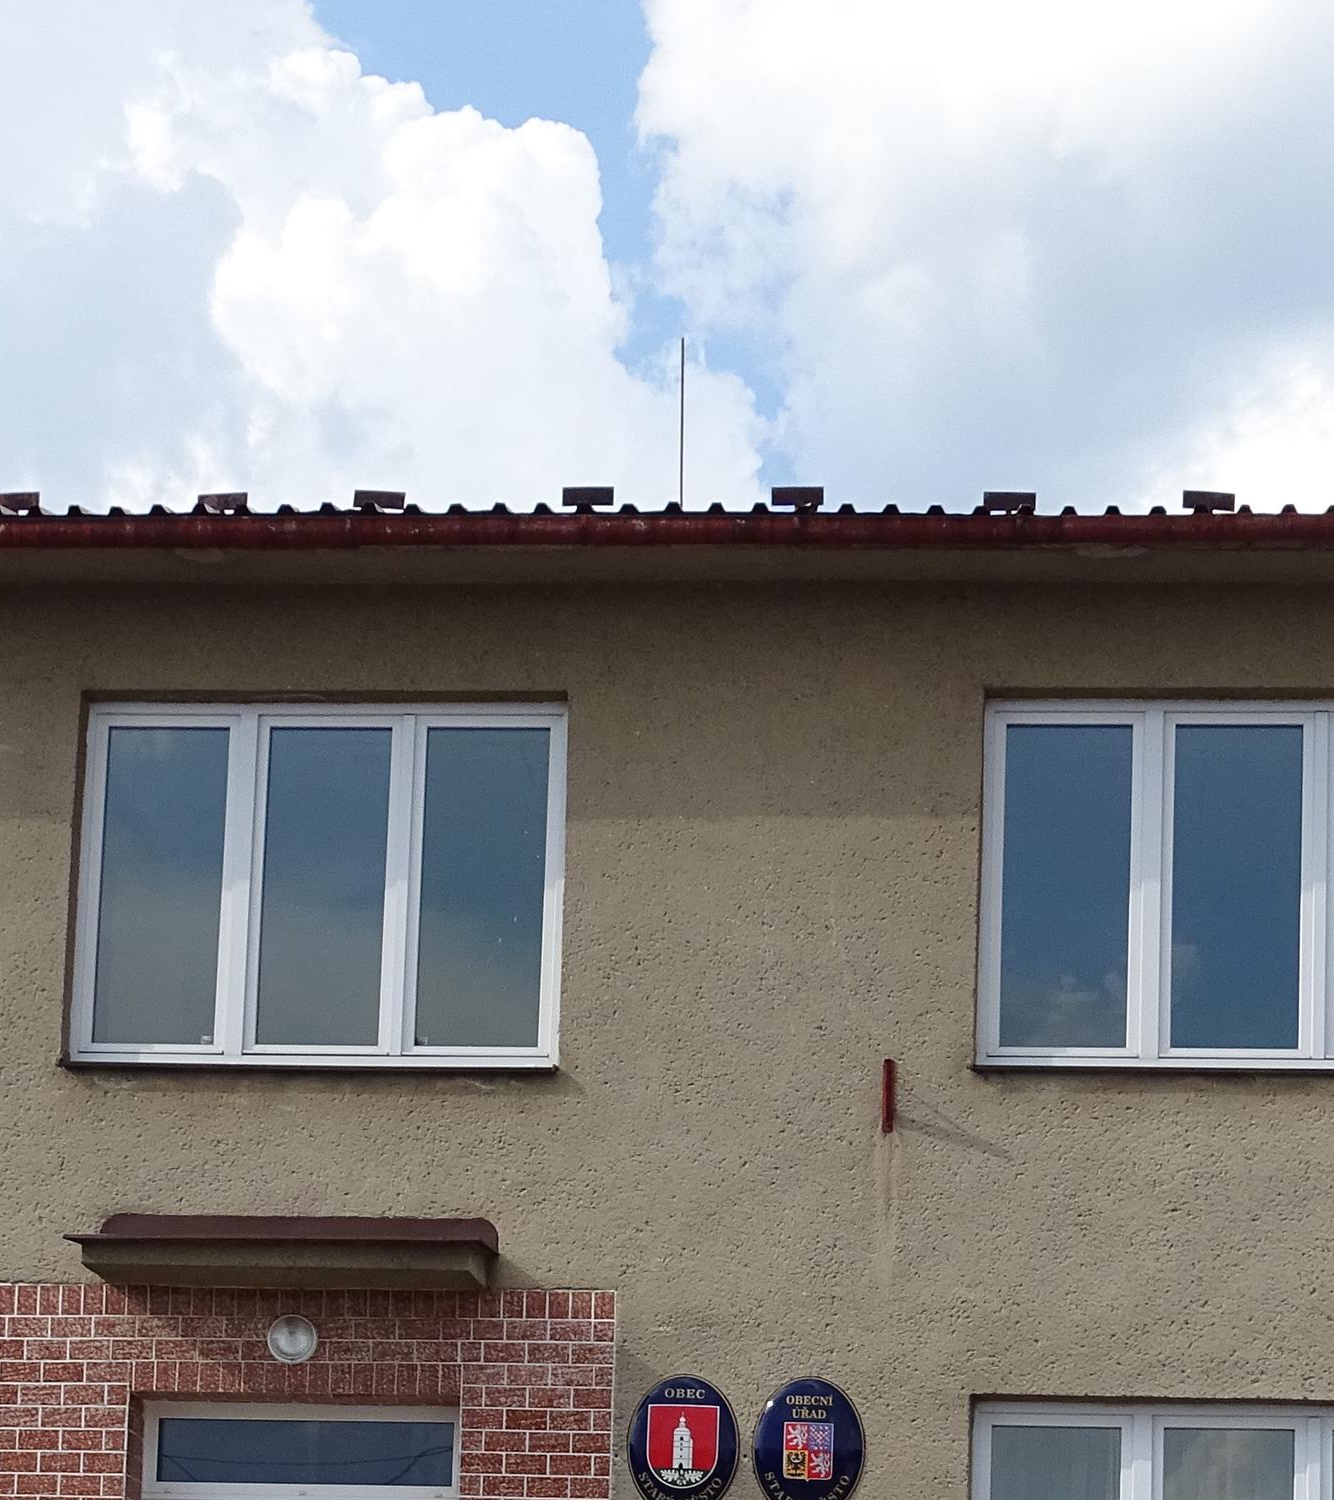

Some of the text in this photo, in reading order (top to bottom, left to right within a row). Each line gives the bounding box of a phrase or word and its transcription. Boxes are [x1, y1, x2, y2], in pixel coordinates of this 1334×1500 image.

[664, 1387, 706, 1400] OBEC
[786, 1394, 834, 1407] OBECNÍ
[792, 1406, 827, 1419] ÚŘAD
